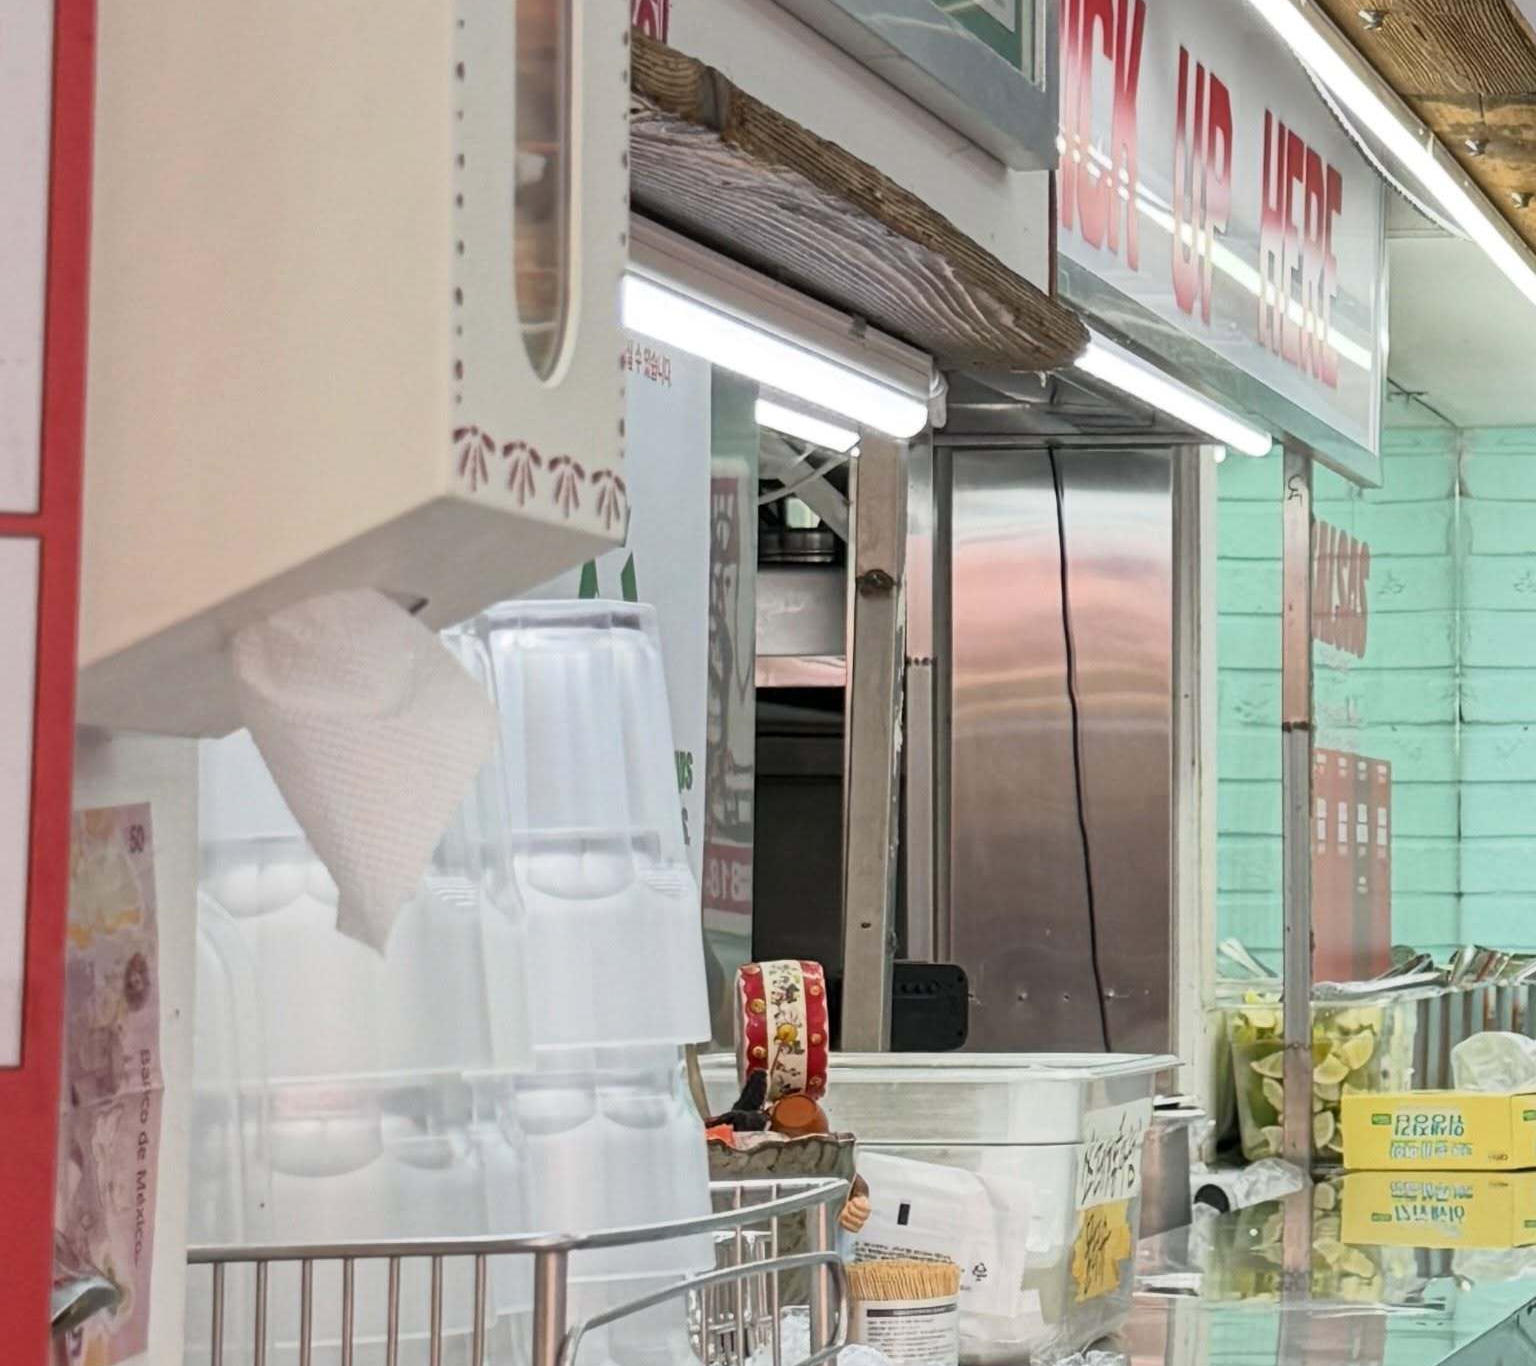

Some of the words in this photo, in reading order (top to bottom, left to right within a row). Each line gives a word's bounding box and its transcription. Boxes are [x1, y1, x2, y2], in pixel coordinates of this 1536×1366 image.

[1171, 44, 1233, 330] UP
[1257, 107, 1343, 391] HERE
[137, 1131, 149, 1161] de
